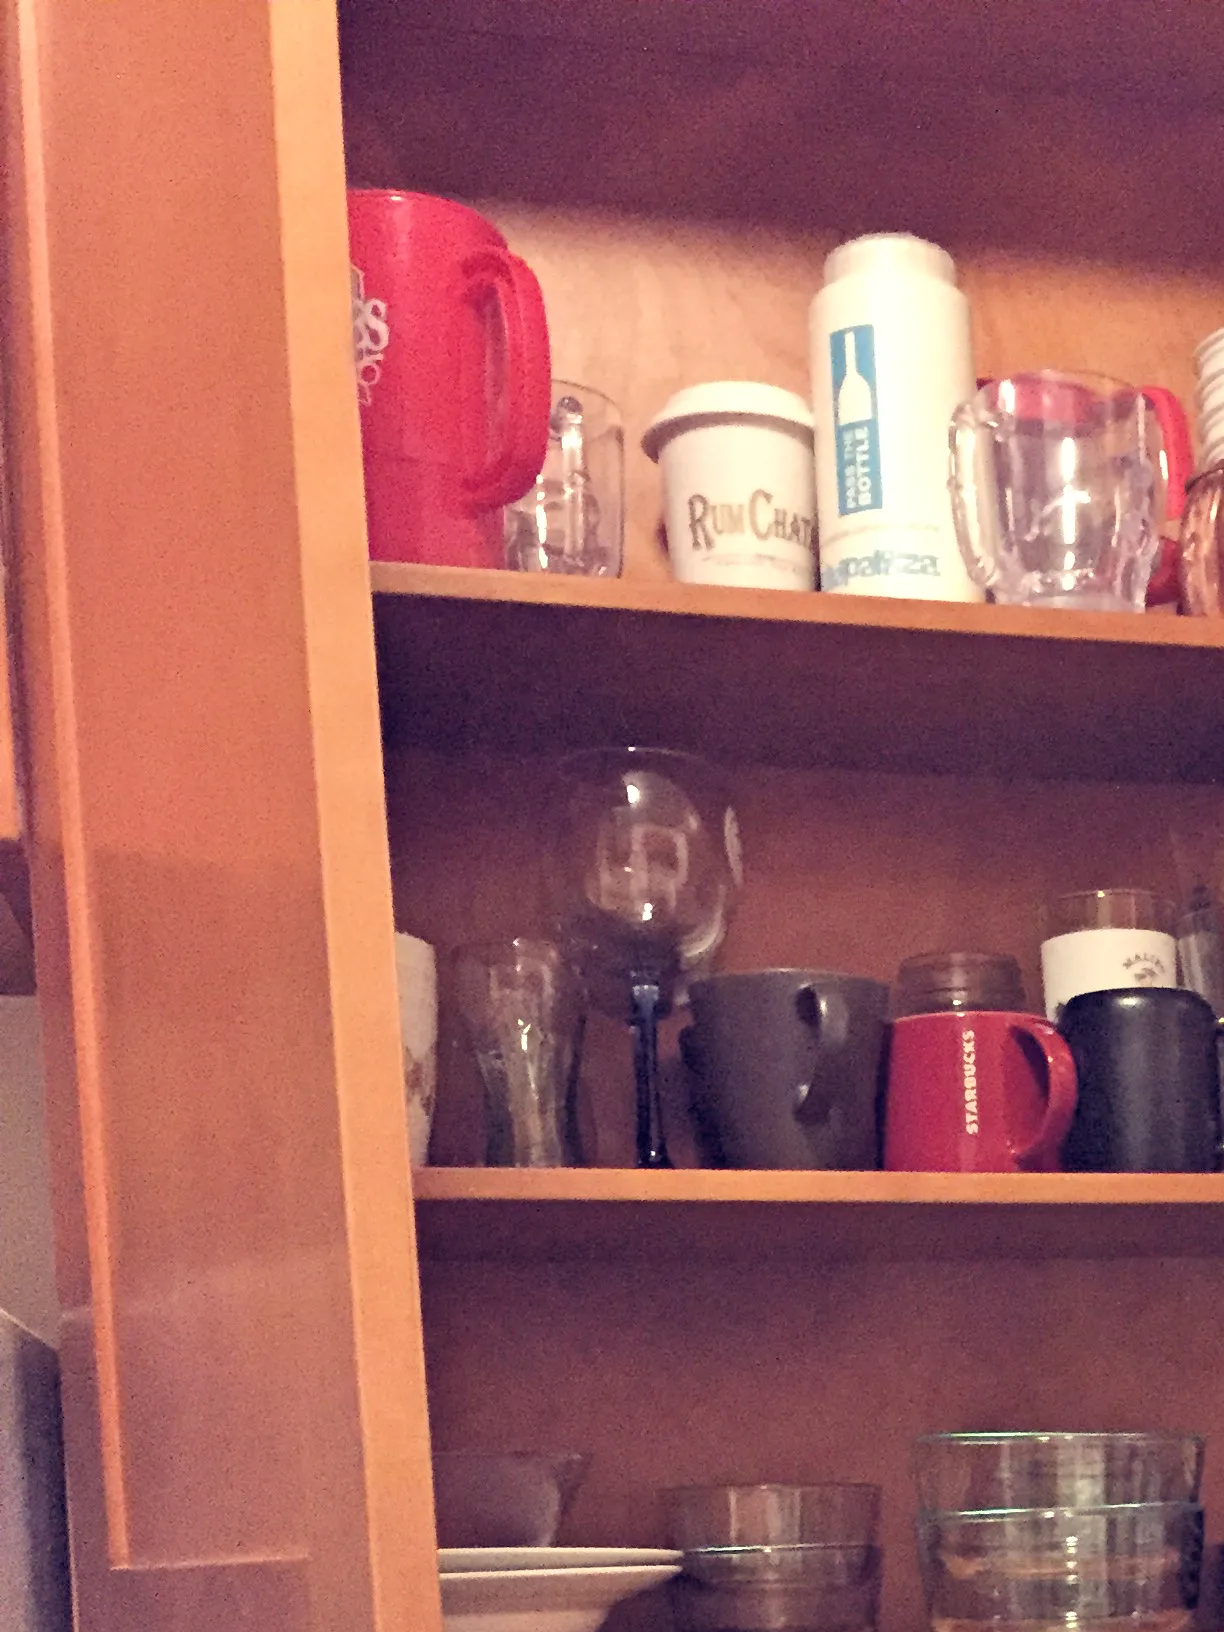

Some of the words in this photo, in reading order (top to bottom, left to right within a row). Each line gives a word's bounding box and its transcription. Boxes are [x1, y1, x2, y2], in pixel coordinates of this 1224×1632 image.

[844, 464, 857, 509] PASS
[855, 426, 872, 506] BOTTLE
[687, 488, 815, 550] RUMCHAT
[961, 1028, 979, 1135] STARBUCKS
